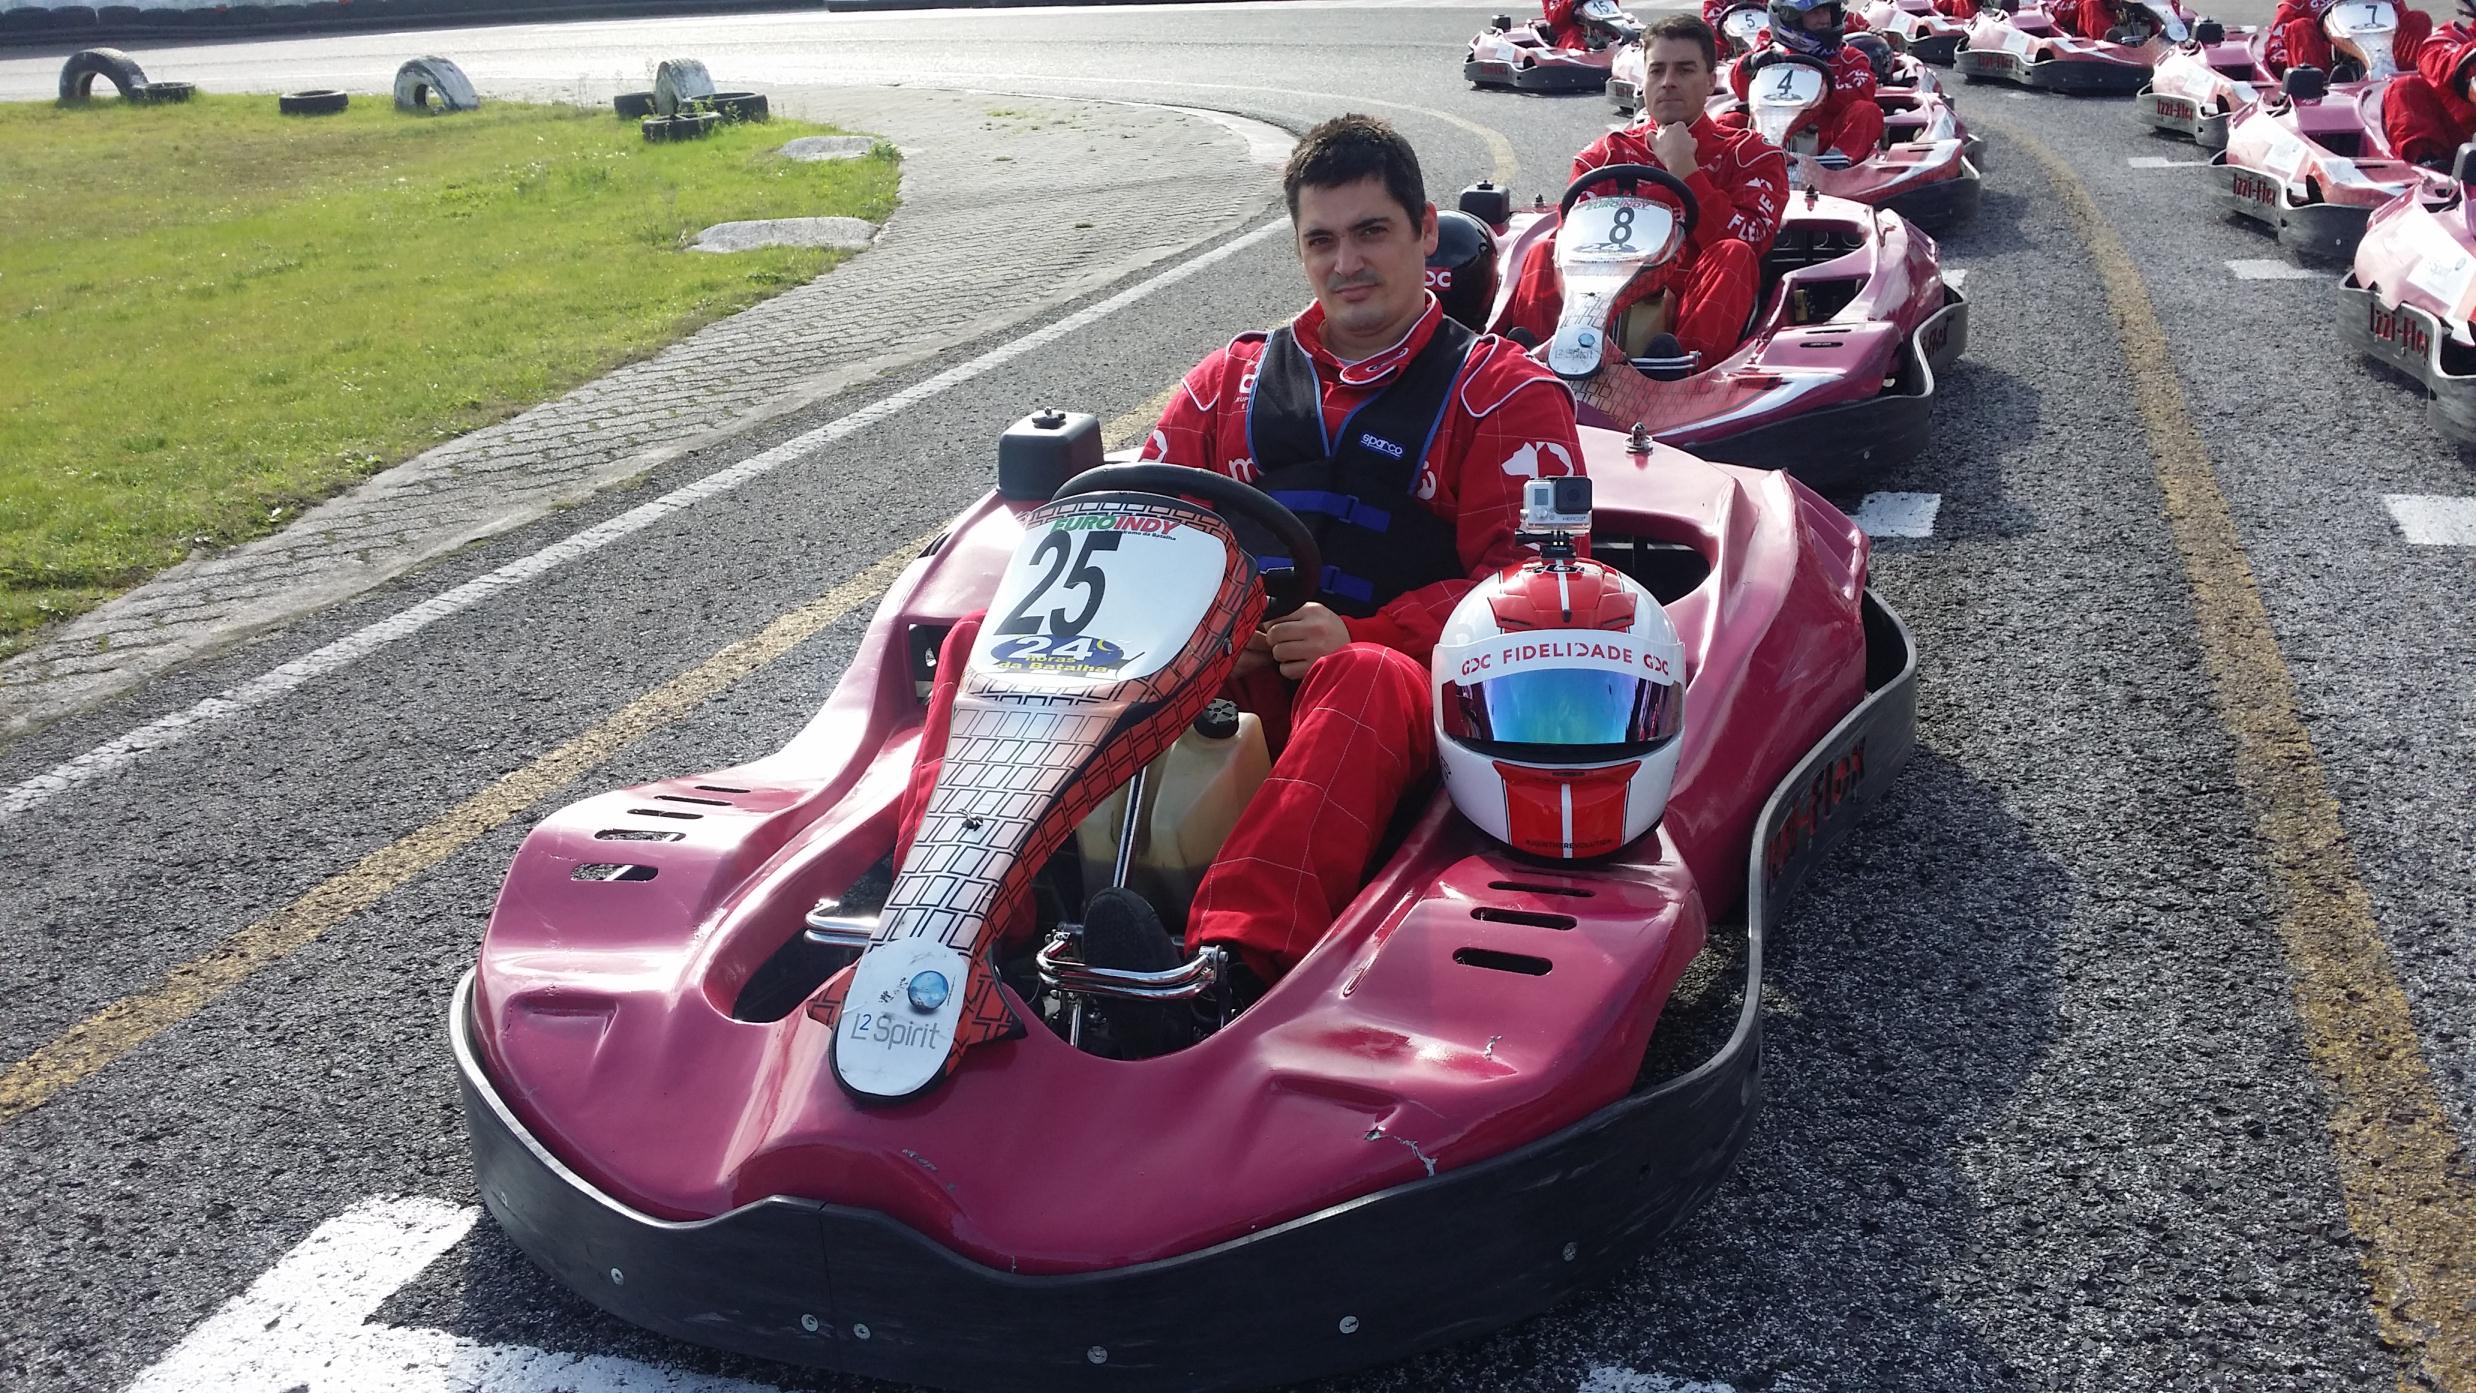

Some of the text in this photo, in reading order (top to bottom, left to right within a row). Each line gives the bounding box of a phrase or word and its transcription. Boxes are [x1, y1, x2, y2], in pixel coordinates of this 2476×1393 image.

[1593, 1, 1609, 15] 15
[2365, 5, 2378, 24] 7
[1745, 14, 1755, 28] 5
[1777, 69, 1793, 95] 4
[1608, 207, 1635, 244] 8
[1424, 270, 1452, 287] DC
[1362, 433, 1403, 457] sparco
[1050, 515, 1181, 535] EUROINDY
[993, 529, 1123, 637] 25
[1007, 636, 1094, 661] 24
[1503, 642, 1633, 664] FIDELIDADE
[1029, 662, 1109, 673] Batalha
